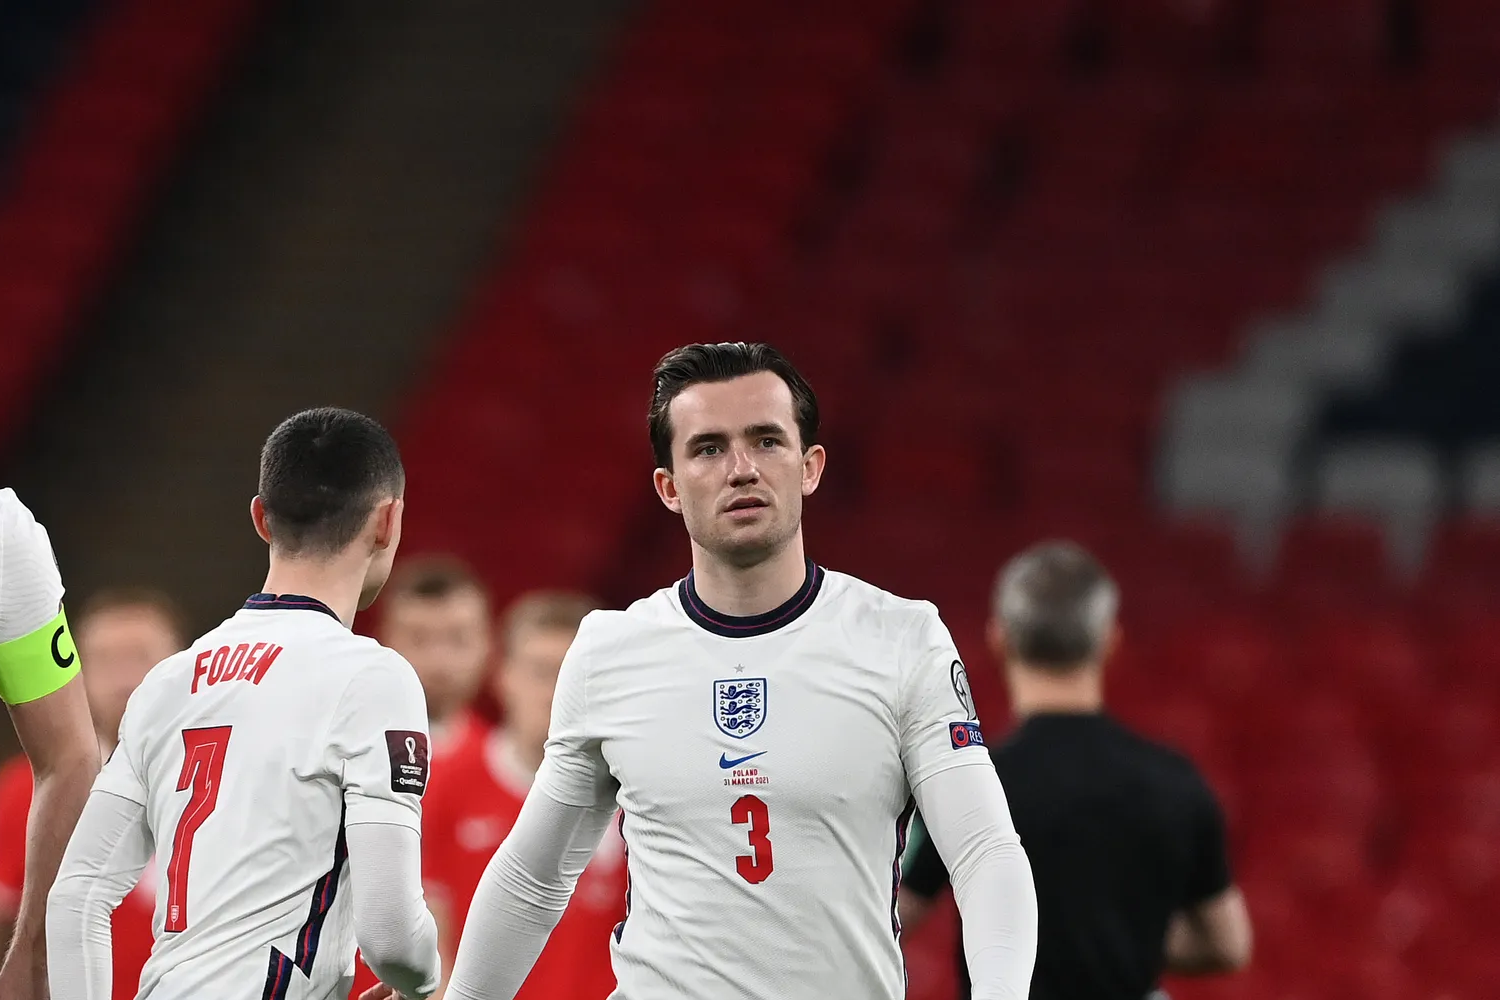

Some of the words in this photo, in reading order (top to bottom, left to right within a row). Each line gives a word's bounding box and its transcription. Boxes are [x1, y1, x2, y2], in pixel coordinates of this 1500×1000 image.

[51, 625, 75, 668] C
[190, 641, 284, 695] FODEN
[723, 778, 731, 786] 31
[731, 777, 755, 786] MARCH
[755, 776, 770, 785] 2021
[732, 768, 759, 777] POLAND
[164, 725, 233, 933] 7
[730, 794, 774, 884] 3
